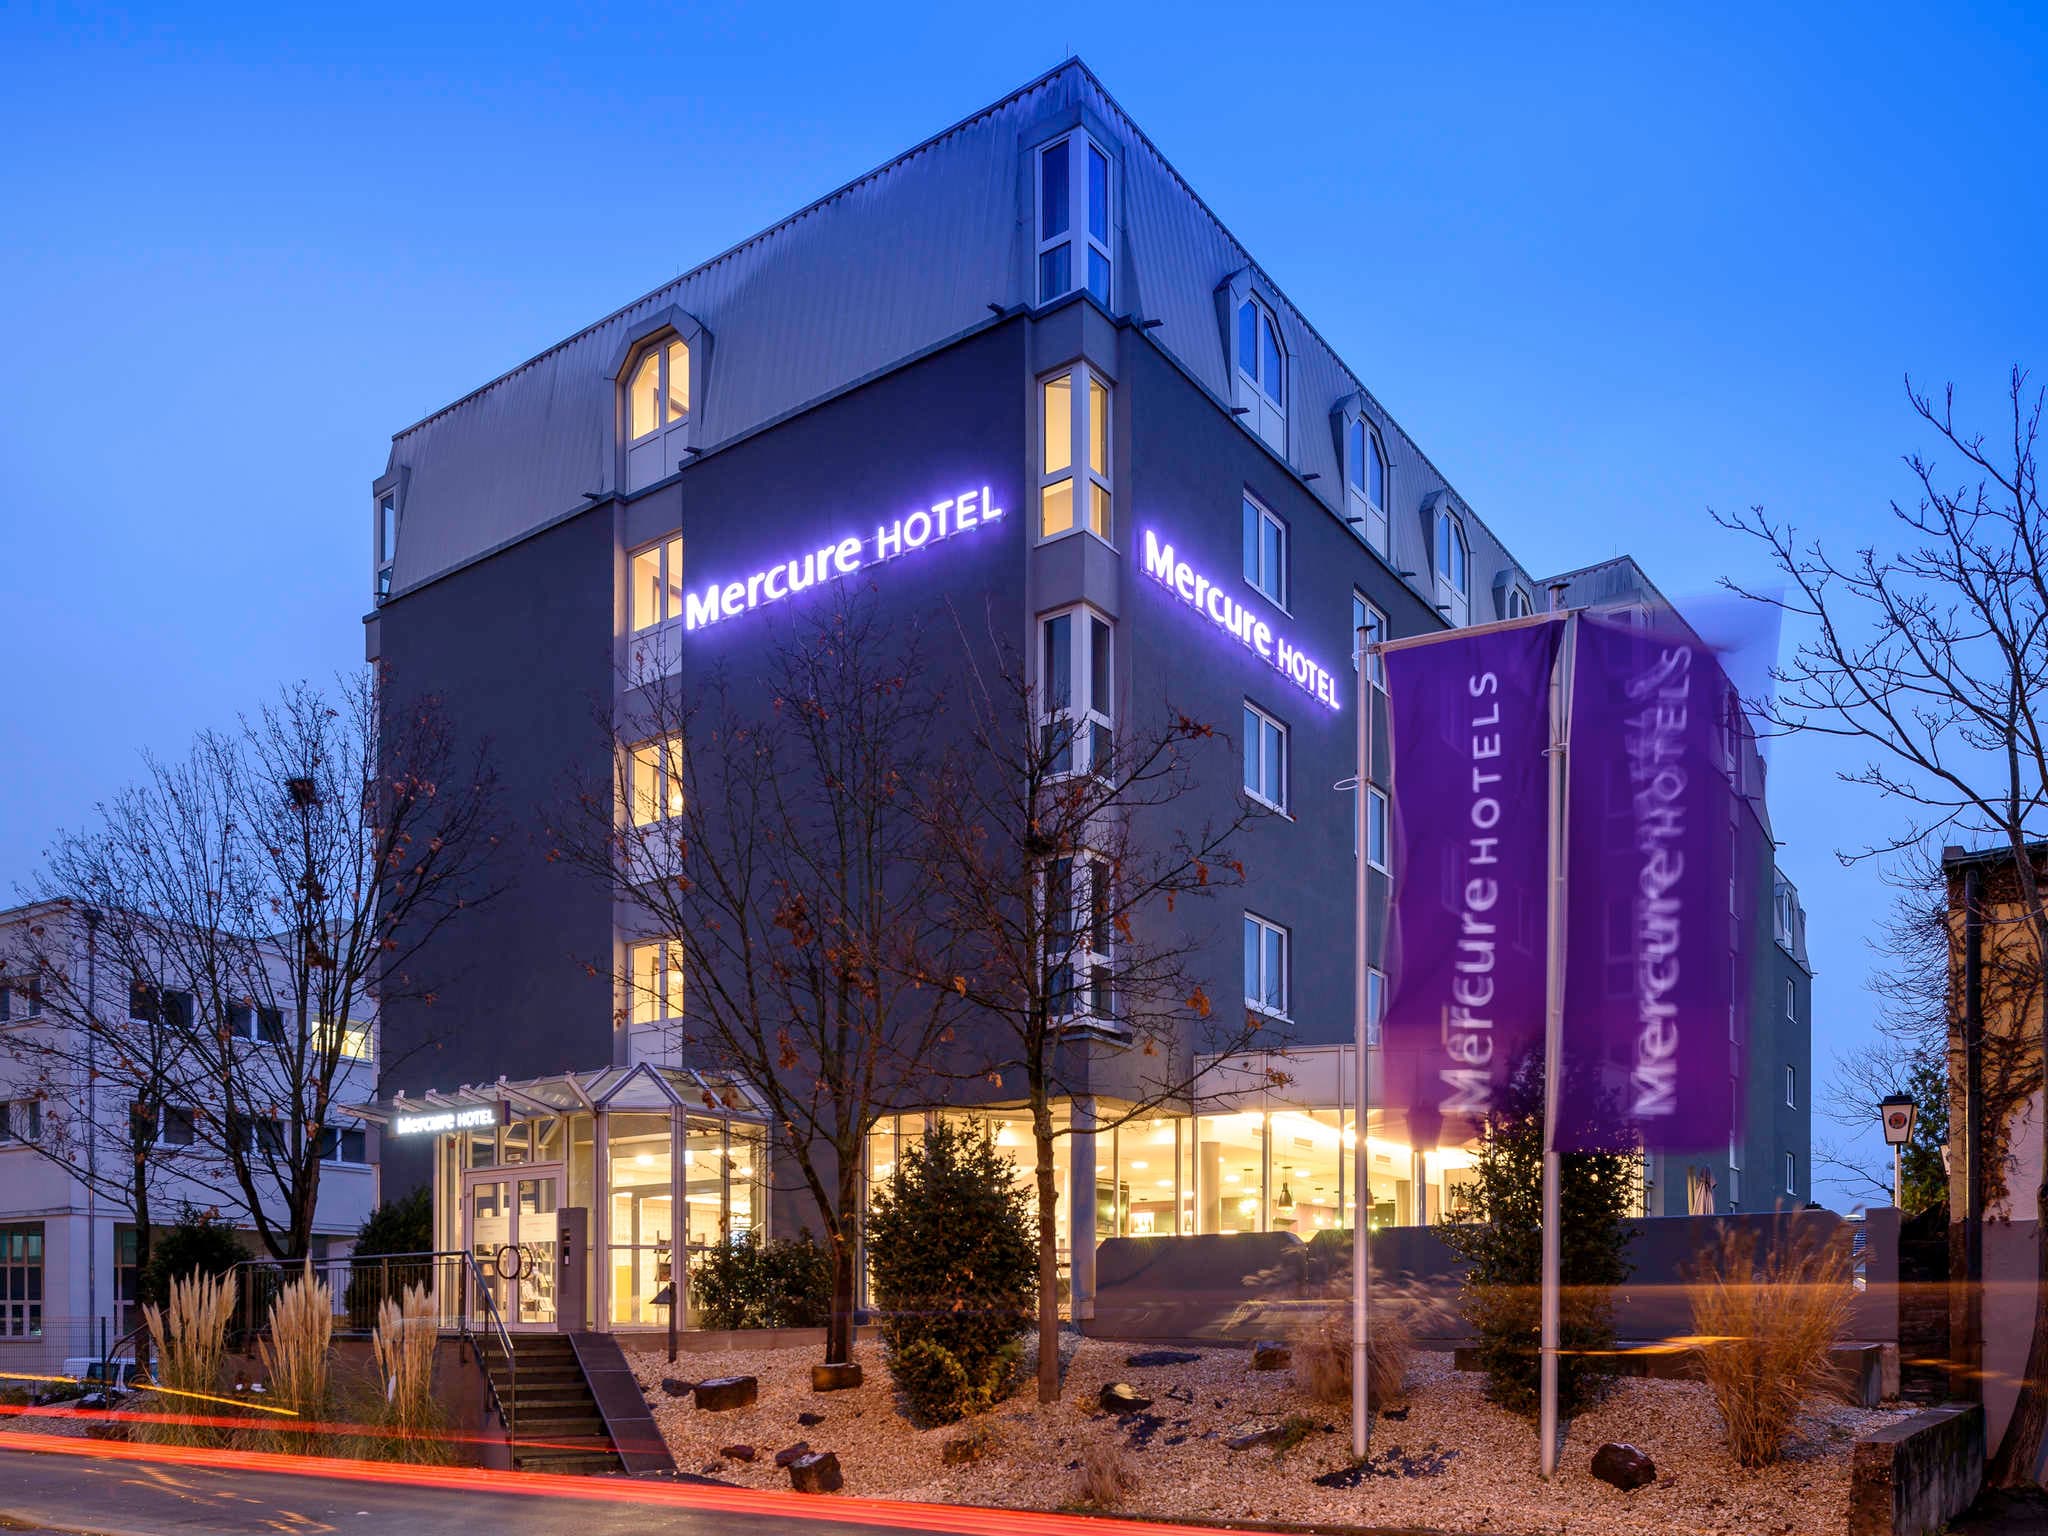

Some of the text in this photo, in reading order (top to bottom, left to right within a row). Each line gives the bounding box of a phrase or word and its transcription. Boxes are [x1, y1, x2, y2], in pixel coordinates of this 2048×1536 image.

[686, 486, 1003, 631] Mercure HOTEL
[1145, 530, 1340, 710] Mercure HOTEL
[1439, 671, 1501, 1113] Mercure HOTELS
[1632, 646, 1692, 1116] Mercure HOTELS
[457, 1109, 495, 1127] HOTEL
